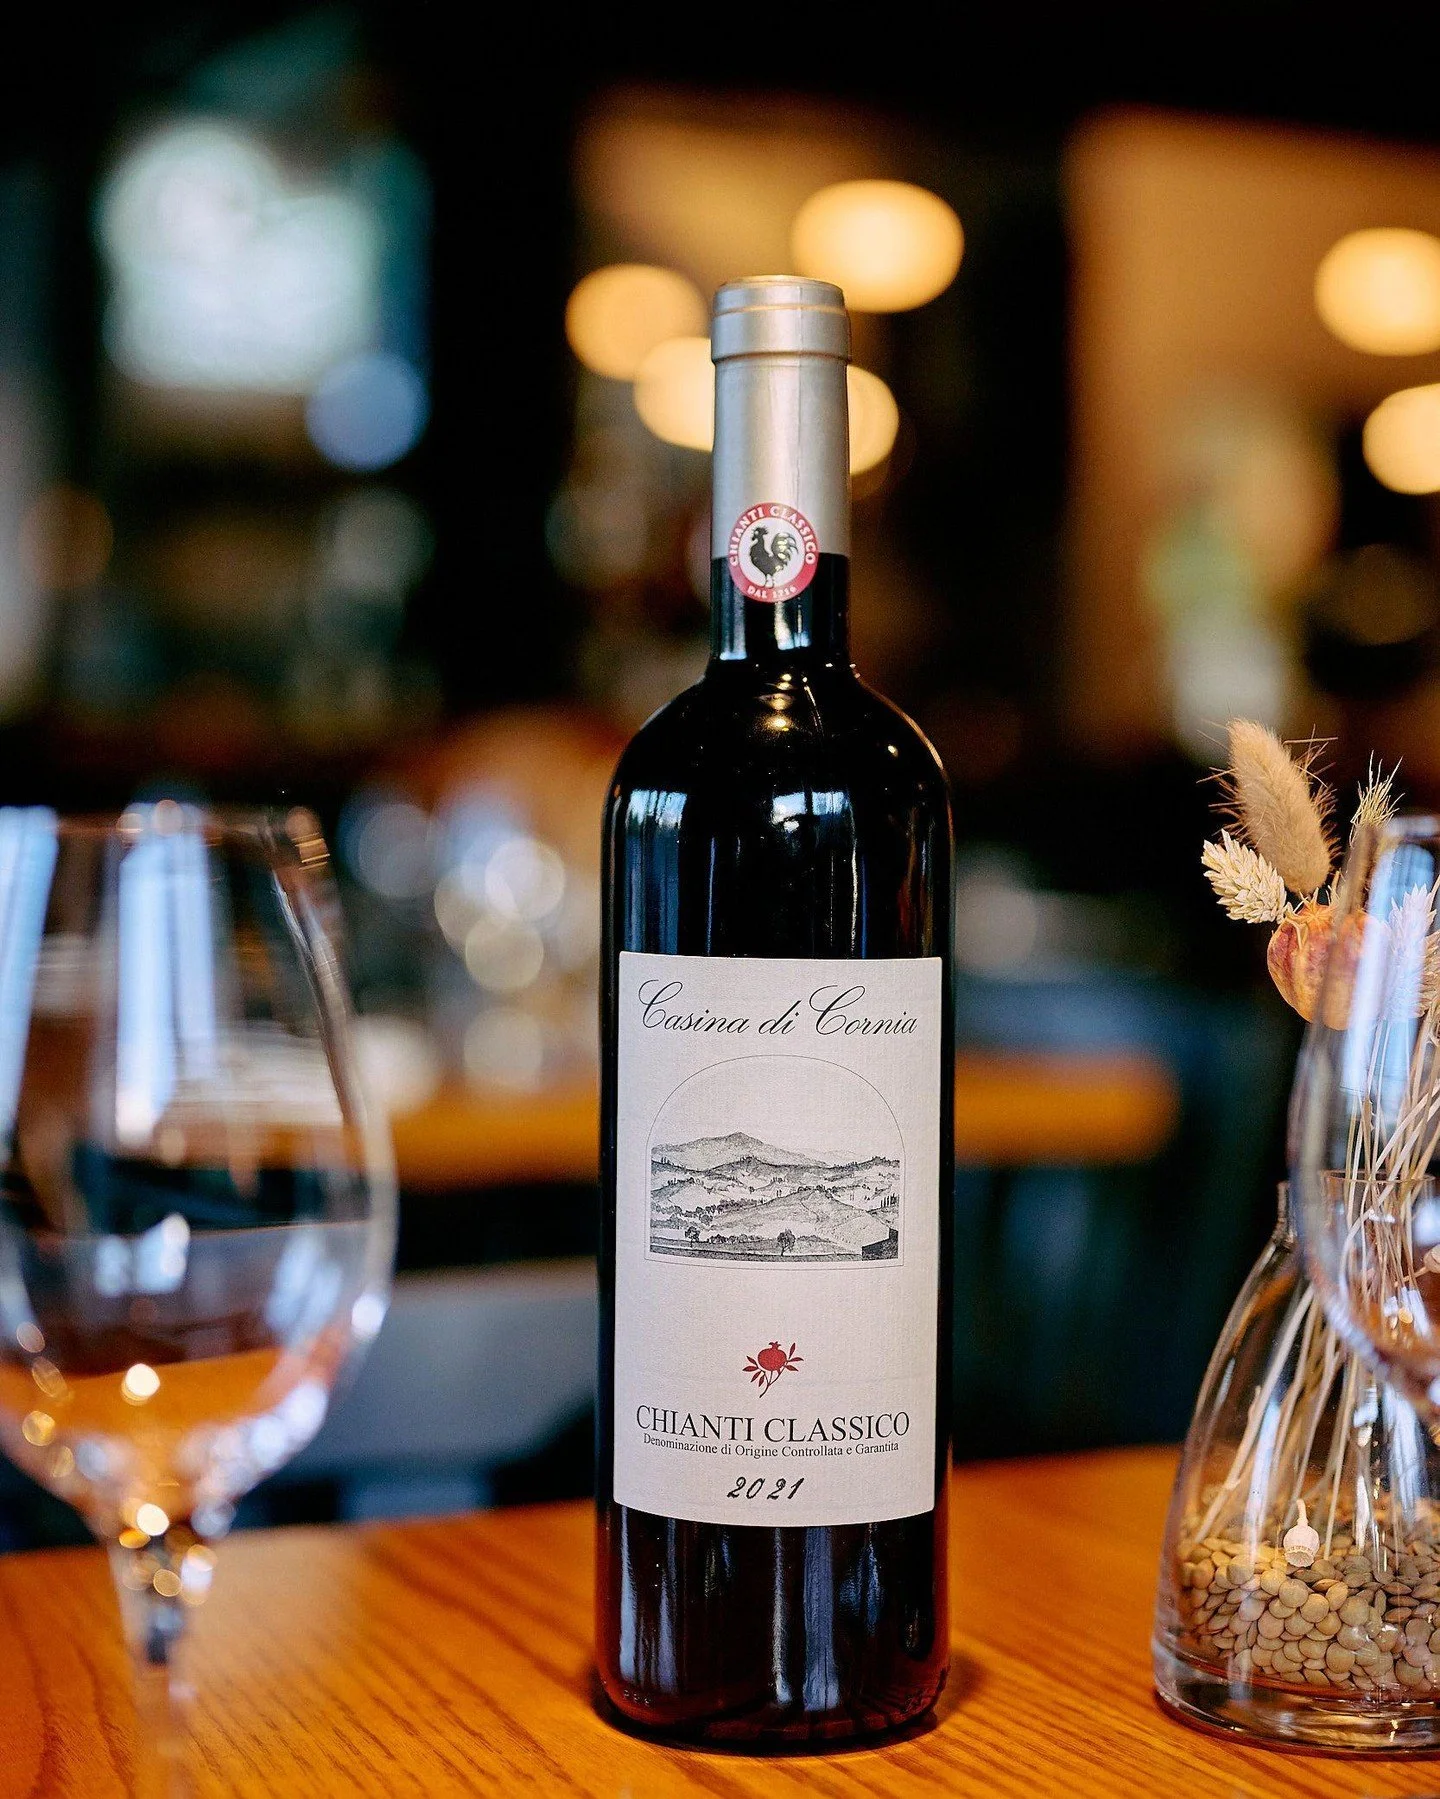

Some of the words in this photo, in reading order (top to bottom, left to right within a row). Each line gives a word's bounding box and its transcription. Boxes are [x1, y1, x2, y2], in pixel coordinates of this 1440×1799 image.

[729, 506, 765, 567] CHIANTI
[769, 505, 817, 565] CLASSICO
[747, 585, 767, 599] DAL
[638, 979, 750, 1034] Casina
[758, 999, 802, 1035] di
[808, 984, 918, 1036] Cornia
[636, 1404, 755, 1442] CHIANTI
[763, 1411, 910, 1443] CLASSICO
[643, 1432, 718, 1455] Denominazione
[720, 1443, 732, 1456] di
[735, 1444, 779, 1460] Origine
[781, 1444, 843, 1458] Controllata
[846, 1447, 852, 1456] e
[855, 1440, 900, 1455] Garantita
[726, 1476, 805, 1501] 2021
